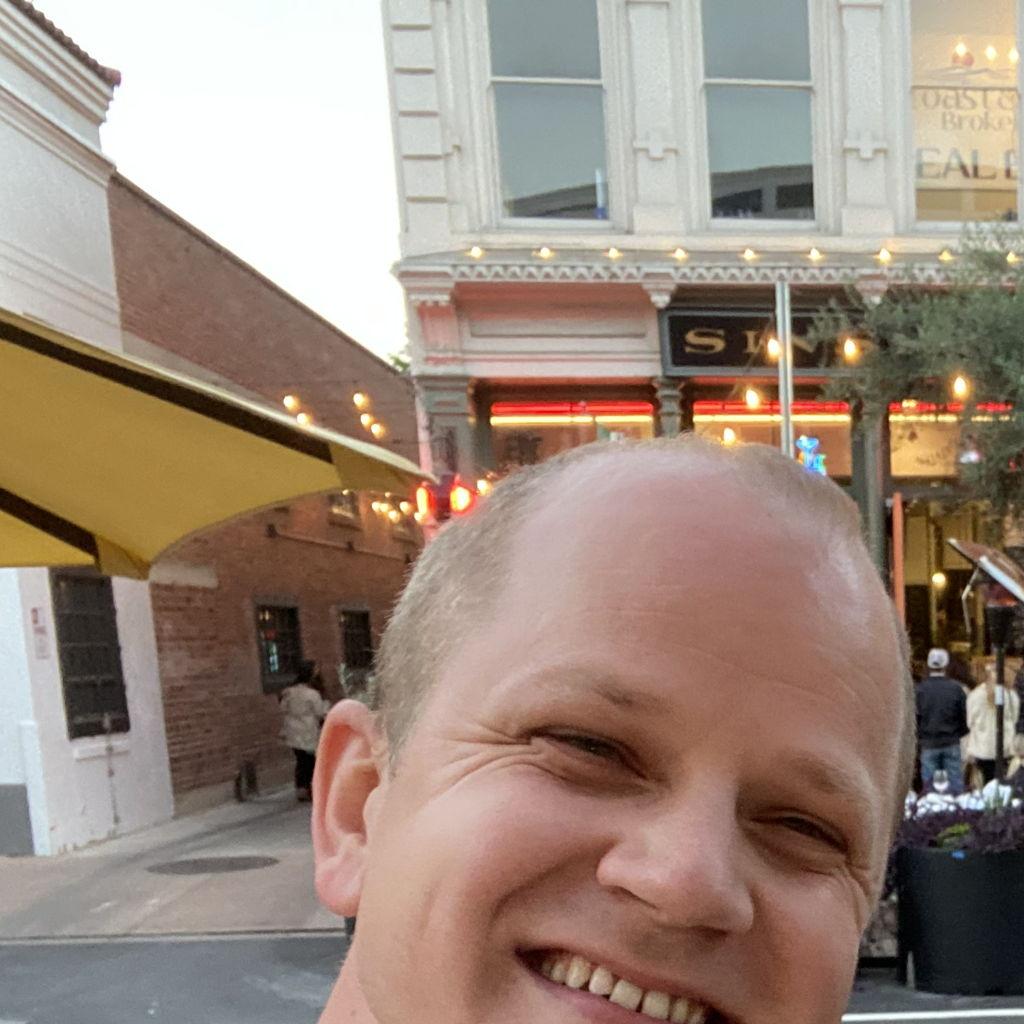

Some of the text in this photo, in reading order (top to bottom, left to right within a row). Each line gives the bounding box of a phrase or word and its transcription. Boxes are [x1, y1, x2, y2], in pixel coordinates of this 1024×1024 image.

[912, 88, 992, 109] oast
[941, 111, 1016, 131] Broke
[915, 147, 998, 180] EAL
